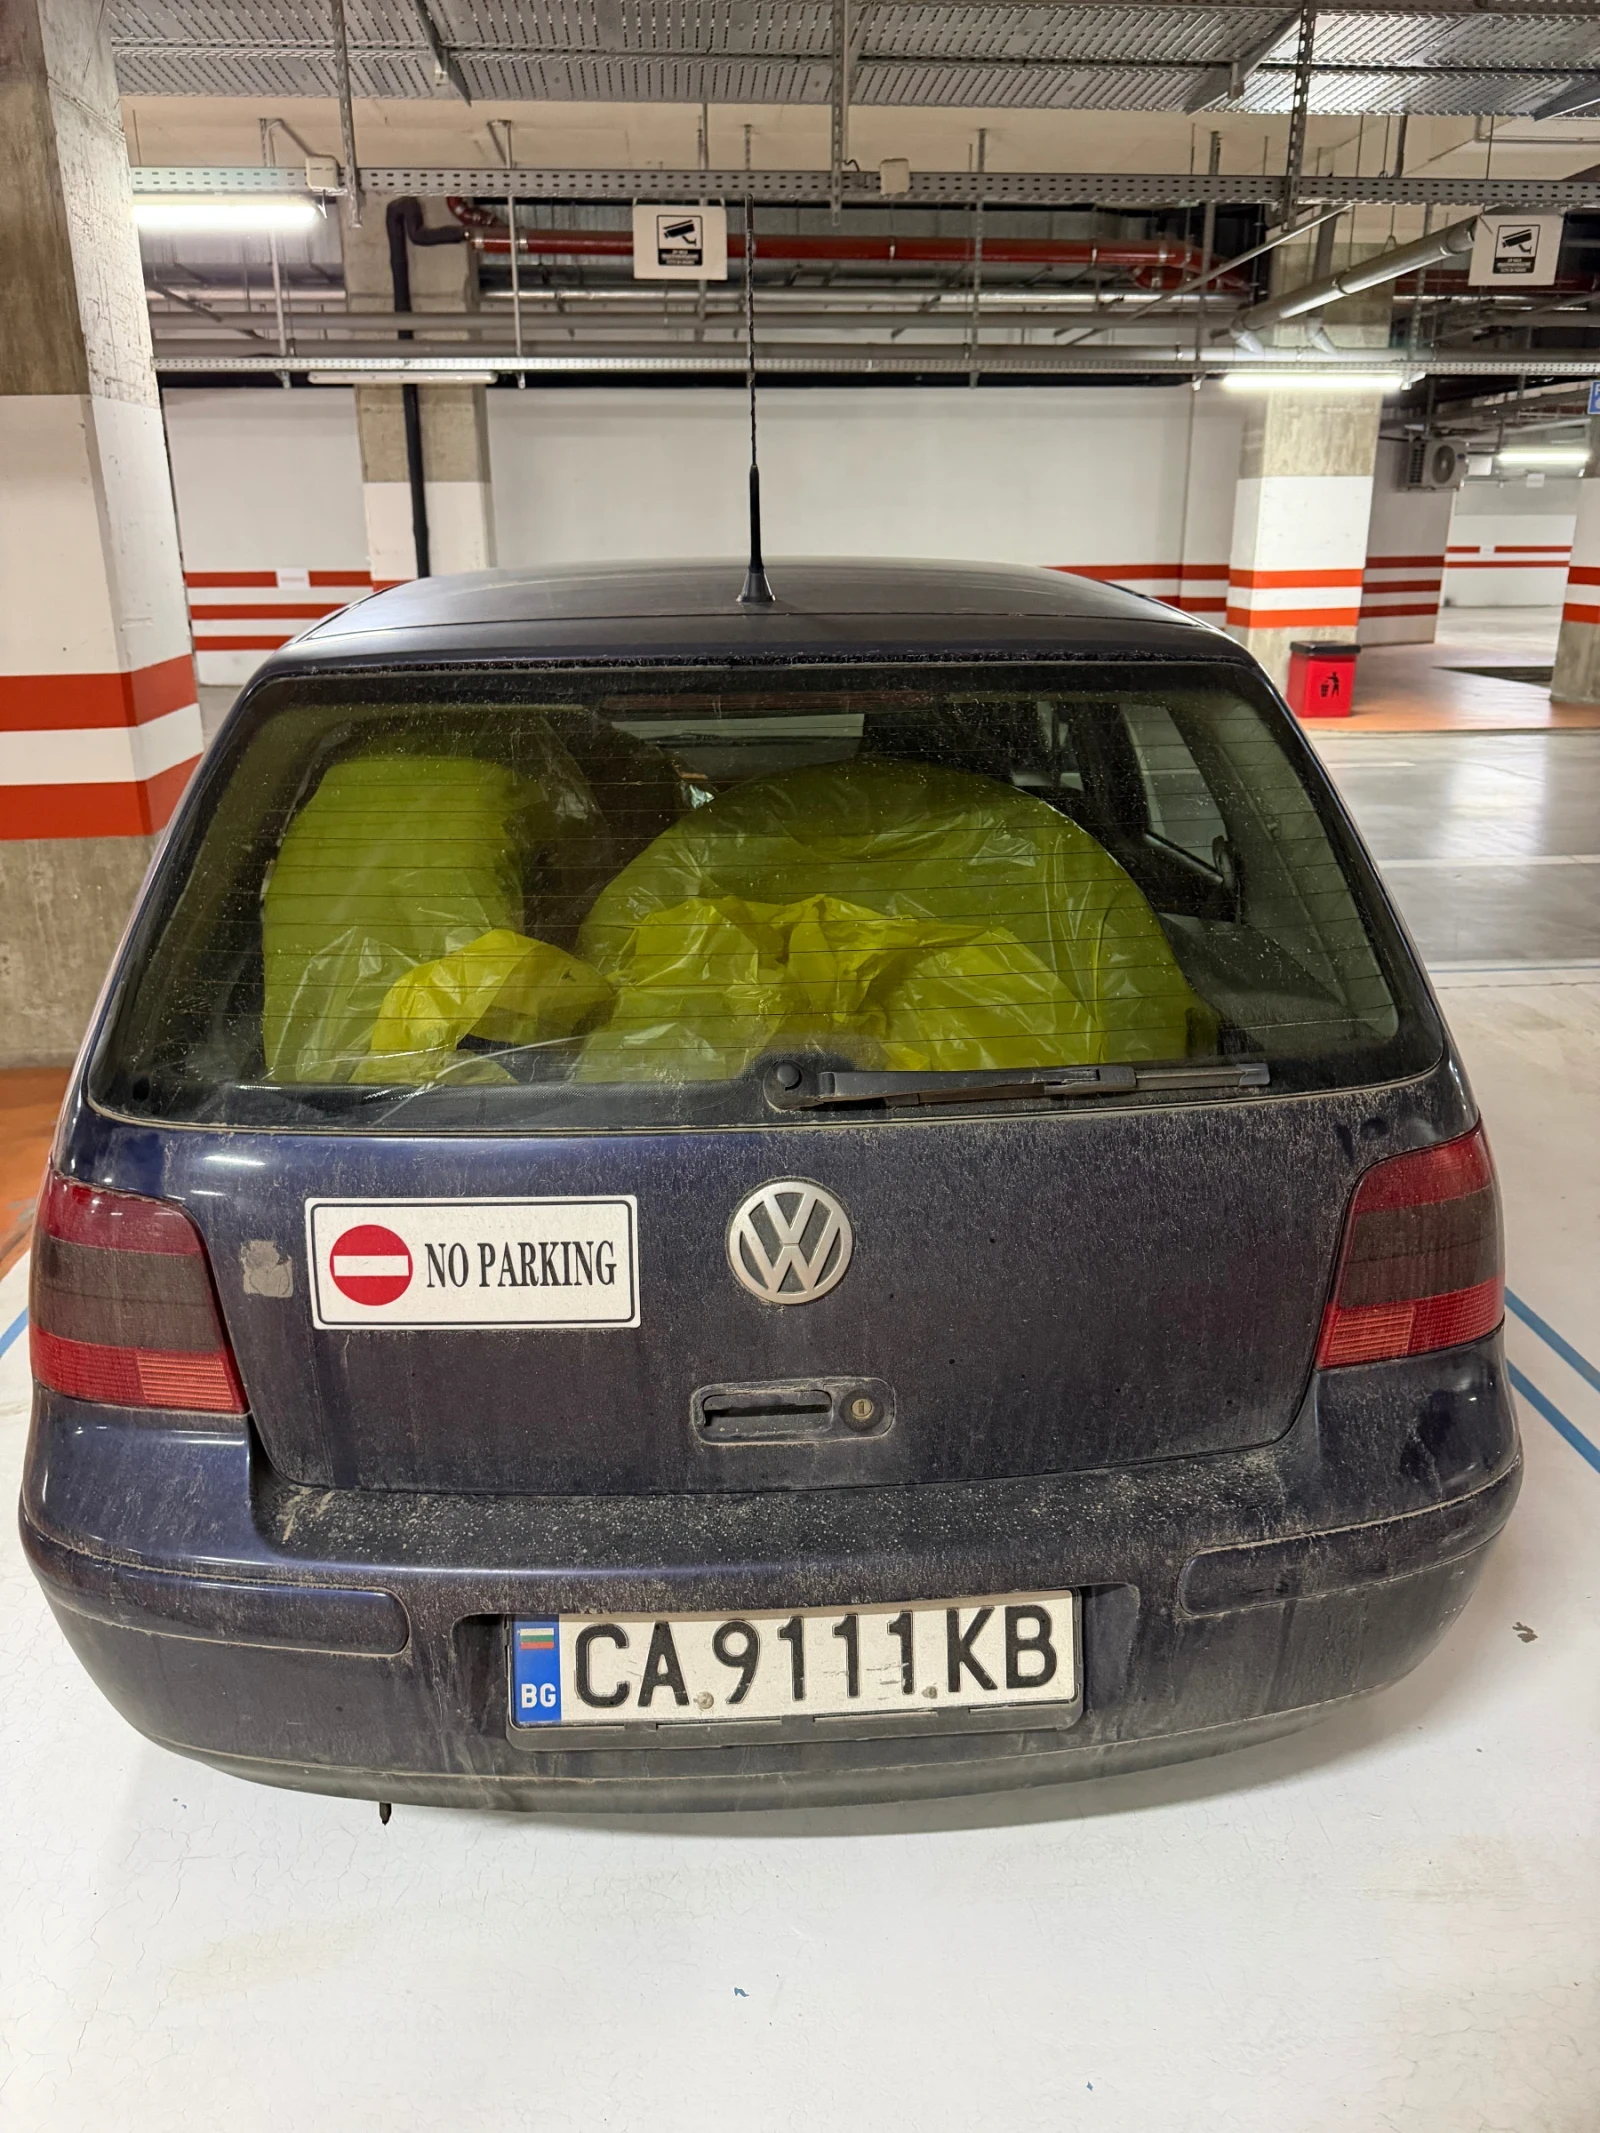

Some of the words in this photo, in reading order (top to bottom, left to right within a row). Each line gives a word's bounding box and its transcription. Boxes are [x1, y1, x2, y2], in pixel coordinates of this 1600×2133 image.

[425, 1243, 469, 1288] NO
[477, 1240, 617, 1287] PARKING
[575, 1621, 689, 1708] CA
[712, 1612, 913, 1704] 9111
[947, 1605, 1057, 1693] KB
[521, 1683, 556, 1709] BG
